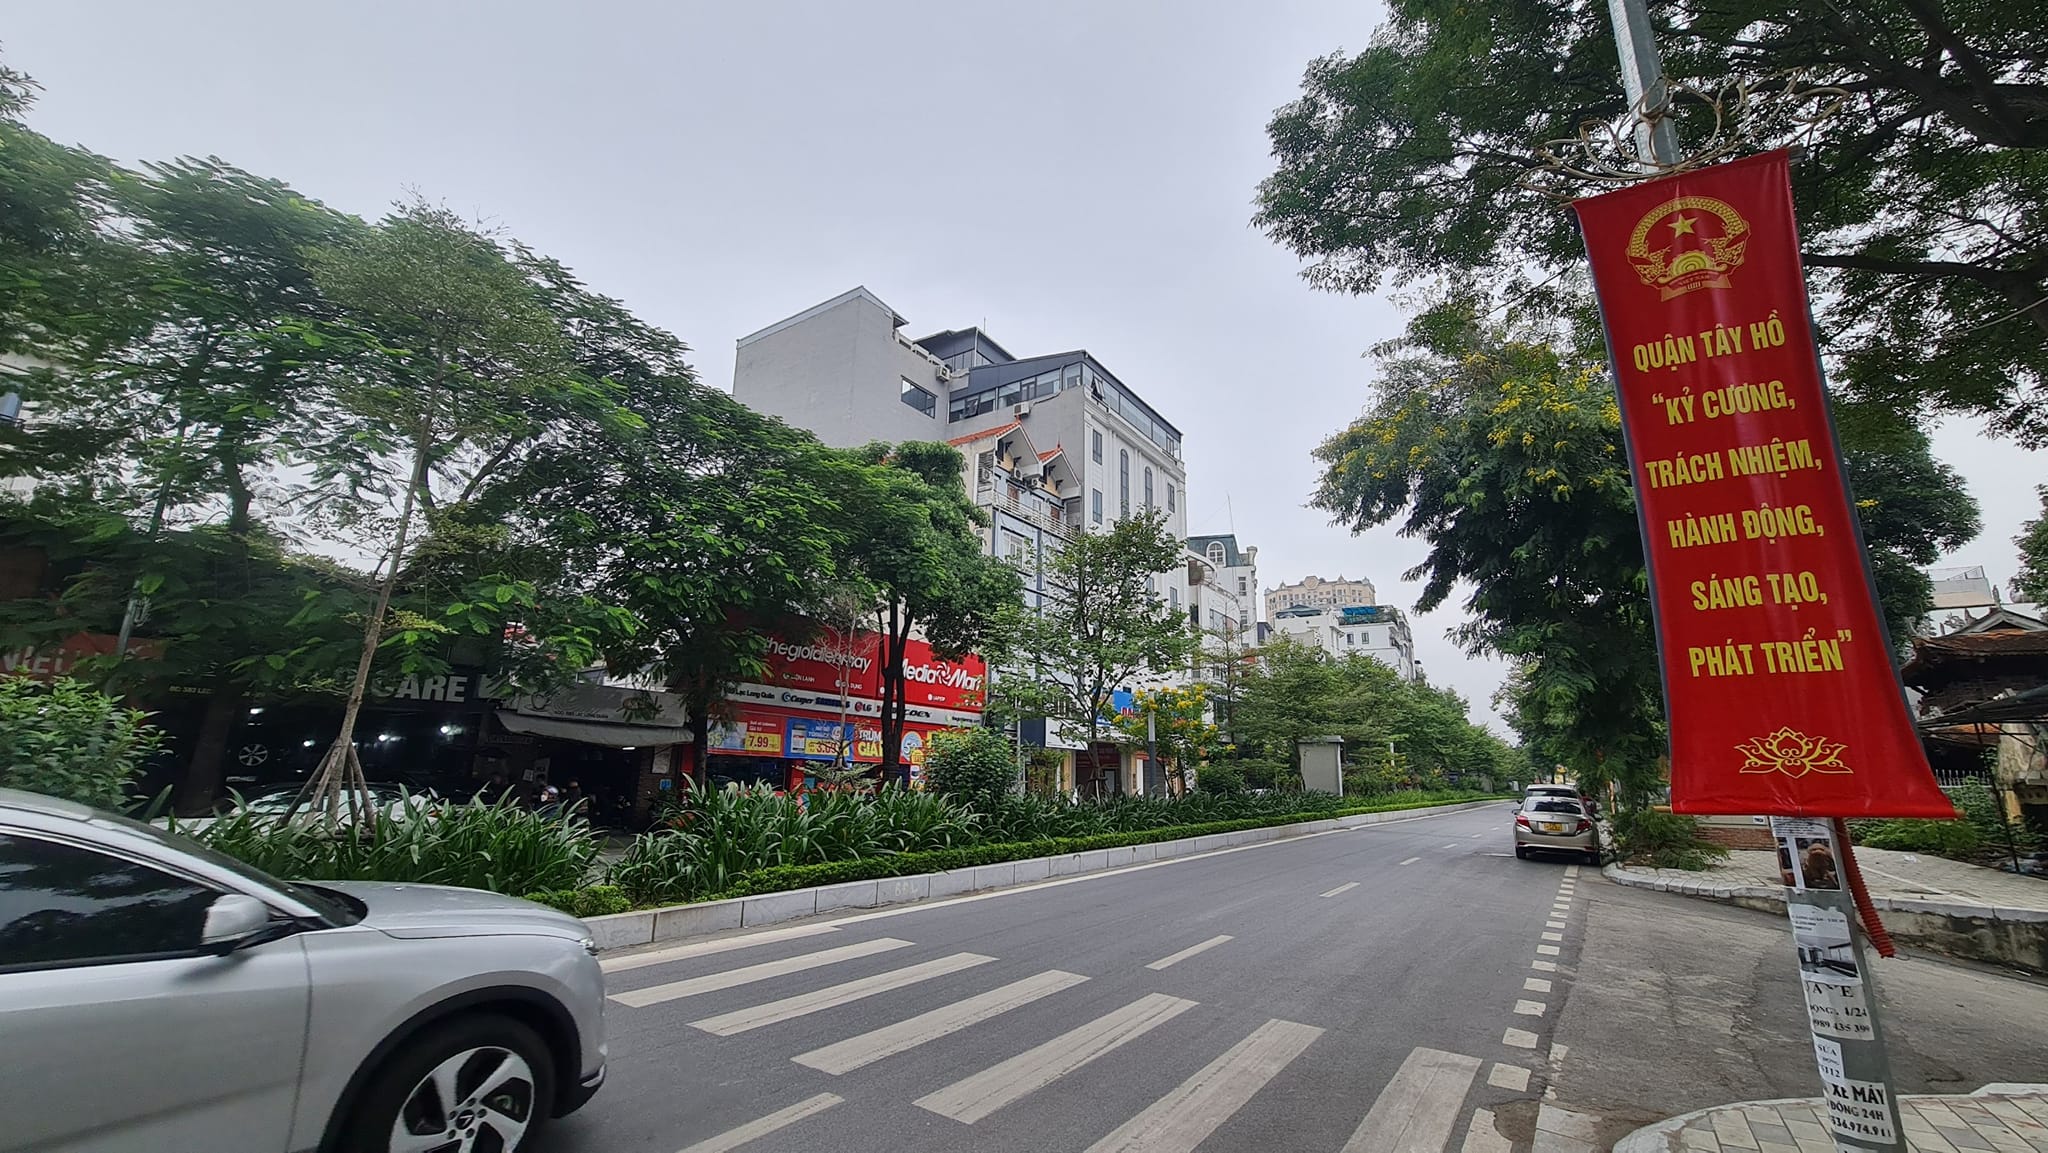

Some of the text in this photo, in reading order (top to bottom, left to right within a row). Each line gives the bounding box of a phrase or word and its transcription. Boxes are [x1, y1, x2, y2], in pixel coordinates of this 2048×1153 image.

[1633, 309, 1786, 373] QUẬN TÂY HỒ
[1703, 380, 1796, 420] CƯƠNG,
[1645, 437, 1823, 489] TRÁCH NHIỆM,
[1667, 502, 1825, 548] HÀNH ĐỘNG,
[1691, 570, 1828, 612] SÁNG TẠO,
[1688, 638, 1753, 678] PHÁT
[1861, 1108, 1885, 1121] 24H
